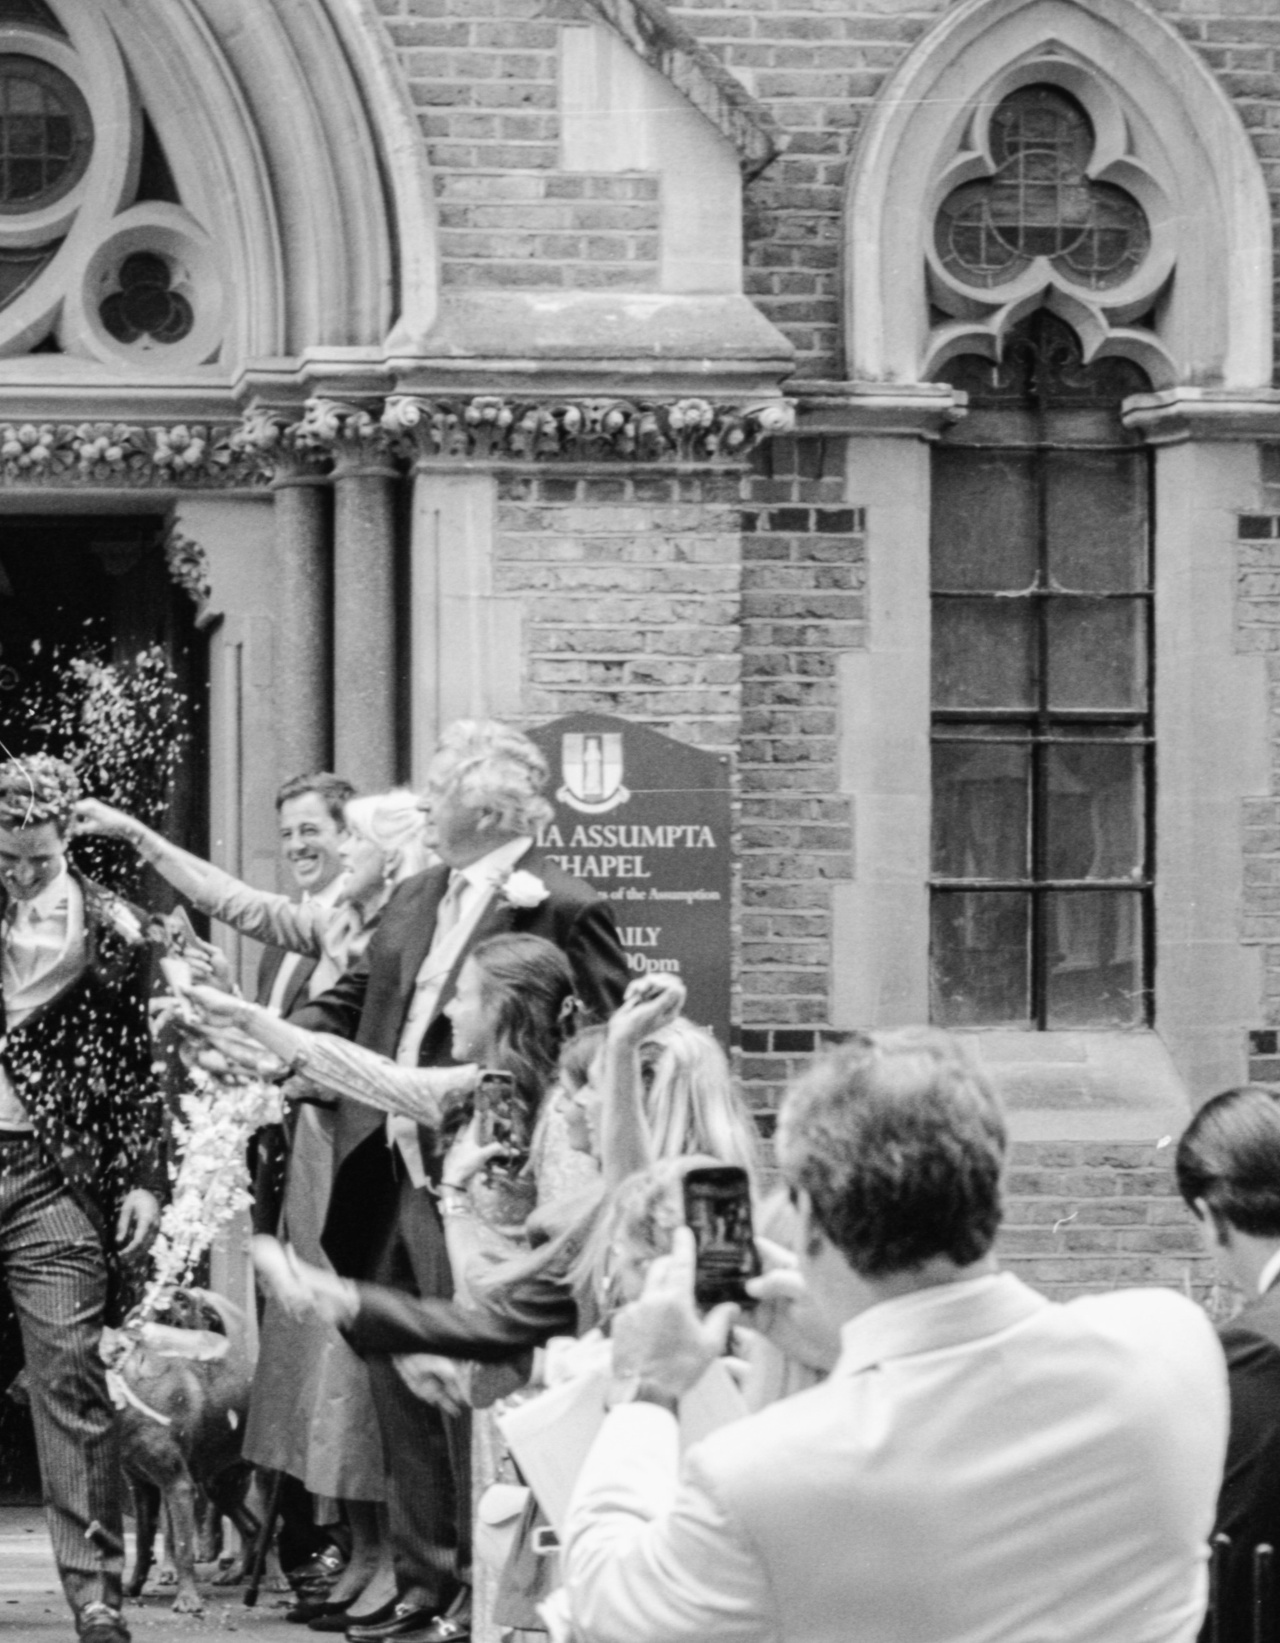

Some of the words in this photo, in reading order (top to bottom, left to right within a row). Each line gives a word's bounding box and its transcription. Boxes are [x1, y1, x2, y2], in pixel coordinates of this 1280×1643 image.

[536, 825, 565, 848] IA
[569, 825, 717, 848] ASSUMPTA
[544, 855, 652, 878] HAPEL
[610, 886, 626, 901] of
[626, 886, 647, 901] the
[648, 887, 721, 905] Assumption
